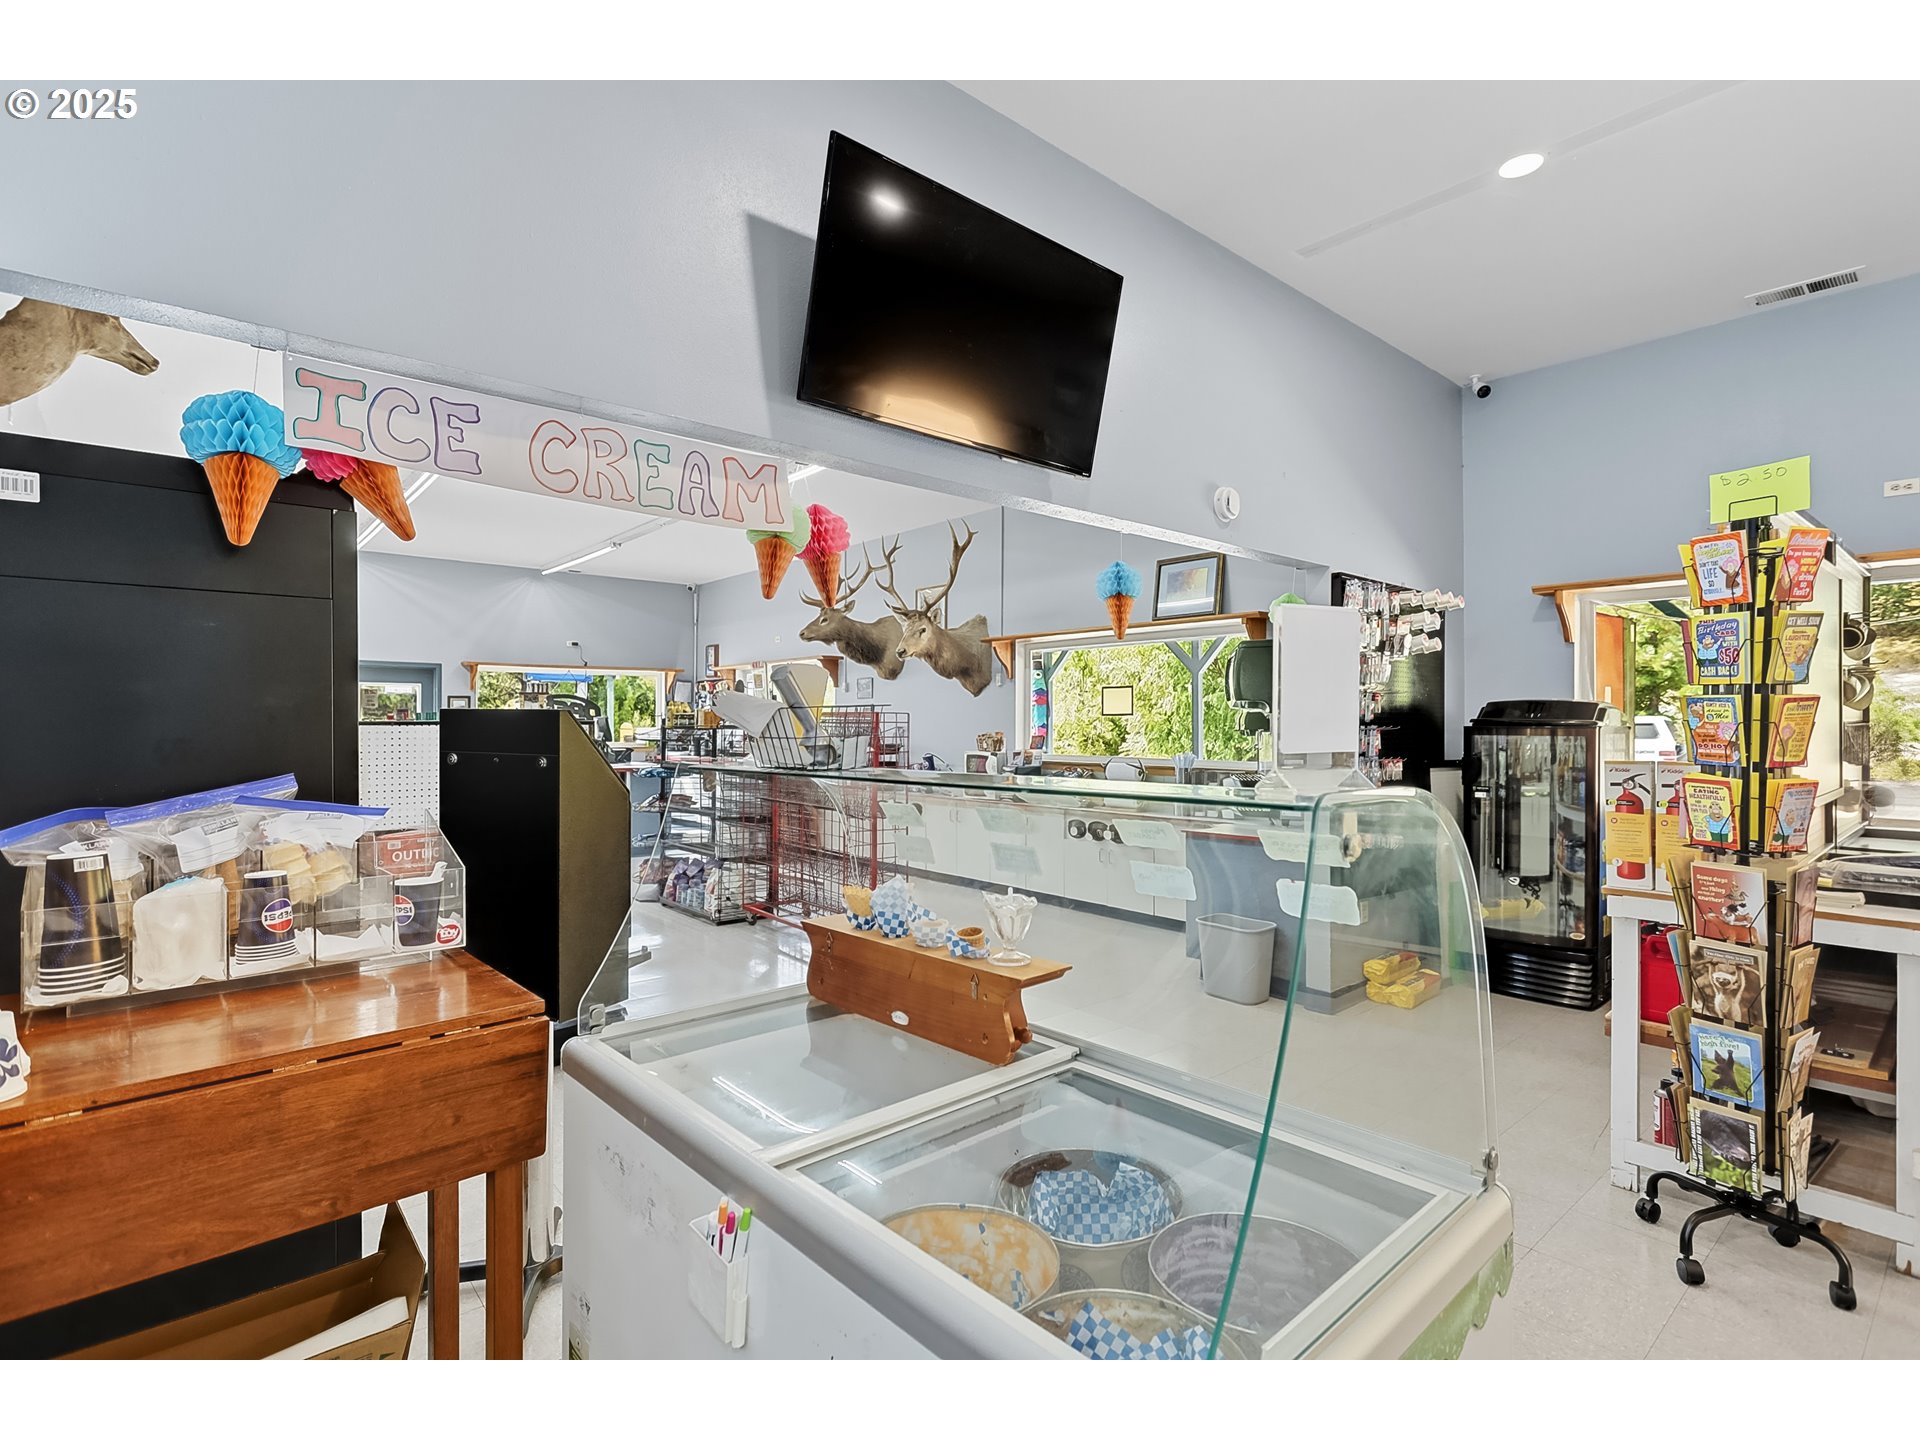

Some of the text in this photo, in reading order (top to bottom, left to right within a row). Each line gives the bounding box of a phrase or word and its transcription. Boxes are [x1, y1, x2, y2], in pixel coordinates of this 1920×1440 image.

[293, 367, 785, 525] ICE CREAM
[1703, 568, 1718, 579] LIFE
[1697, 622, 1737, 635] Birthday
[1719, 647, 1740, 665] $50
[1700, 665, 1737, 676] CASH BACK!
